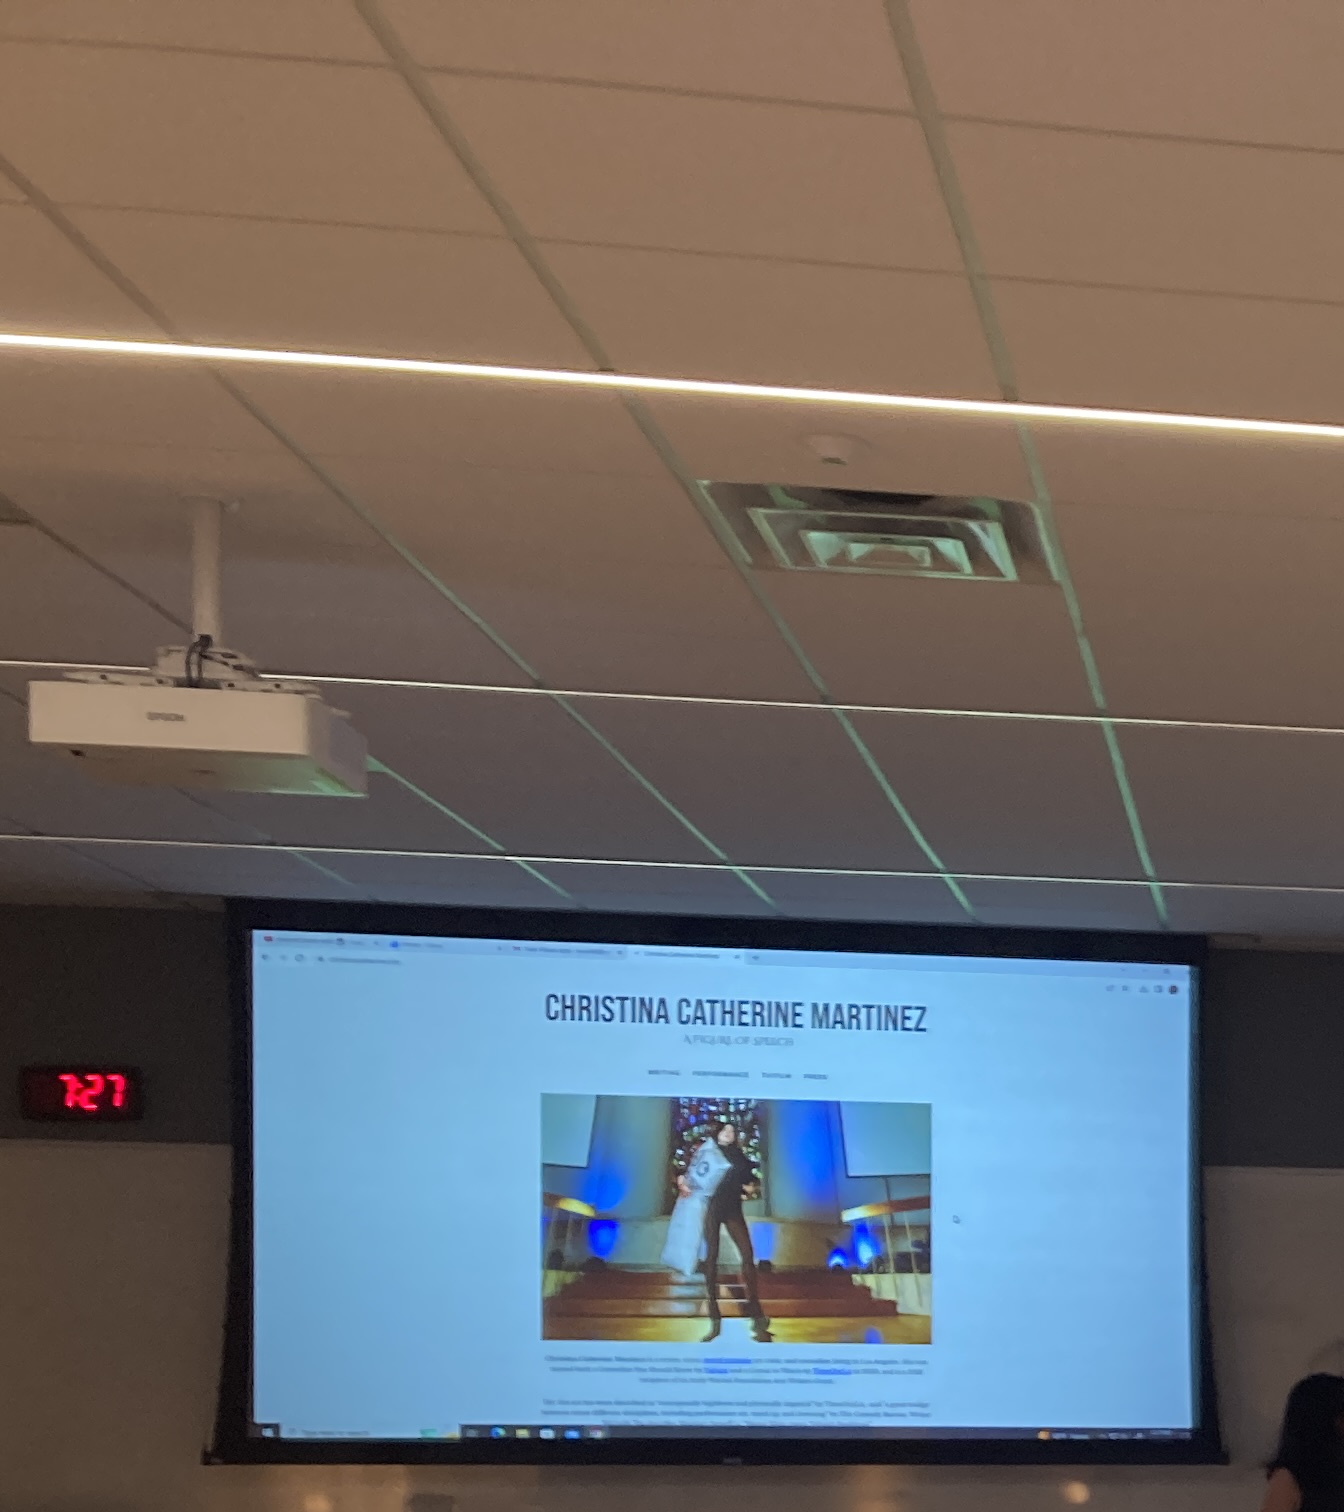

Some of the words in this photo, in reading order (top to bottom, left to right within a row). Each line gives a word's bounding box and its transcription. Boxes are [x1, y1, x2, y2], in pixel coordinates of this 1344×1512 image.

[545, 993, 671, 1025] CHRISTINA
[677, 998, 804, 1029] CATHERINE
[811, 1002, 927, 1033] MARTINEZ
[59, 1073, 126, 1111] 7:27
